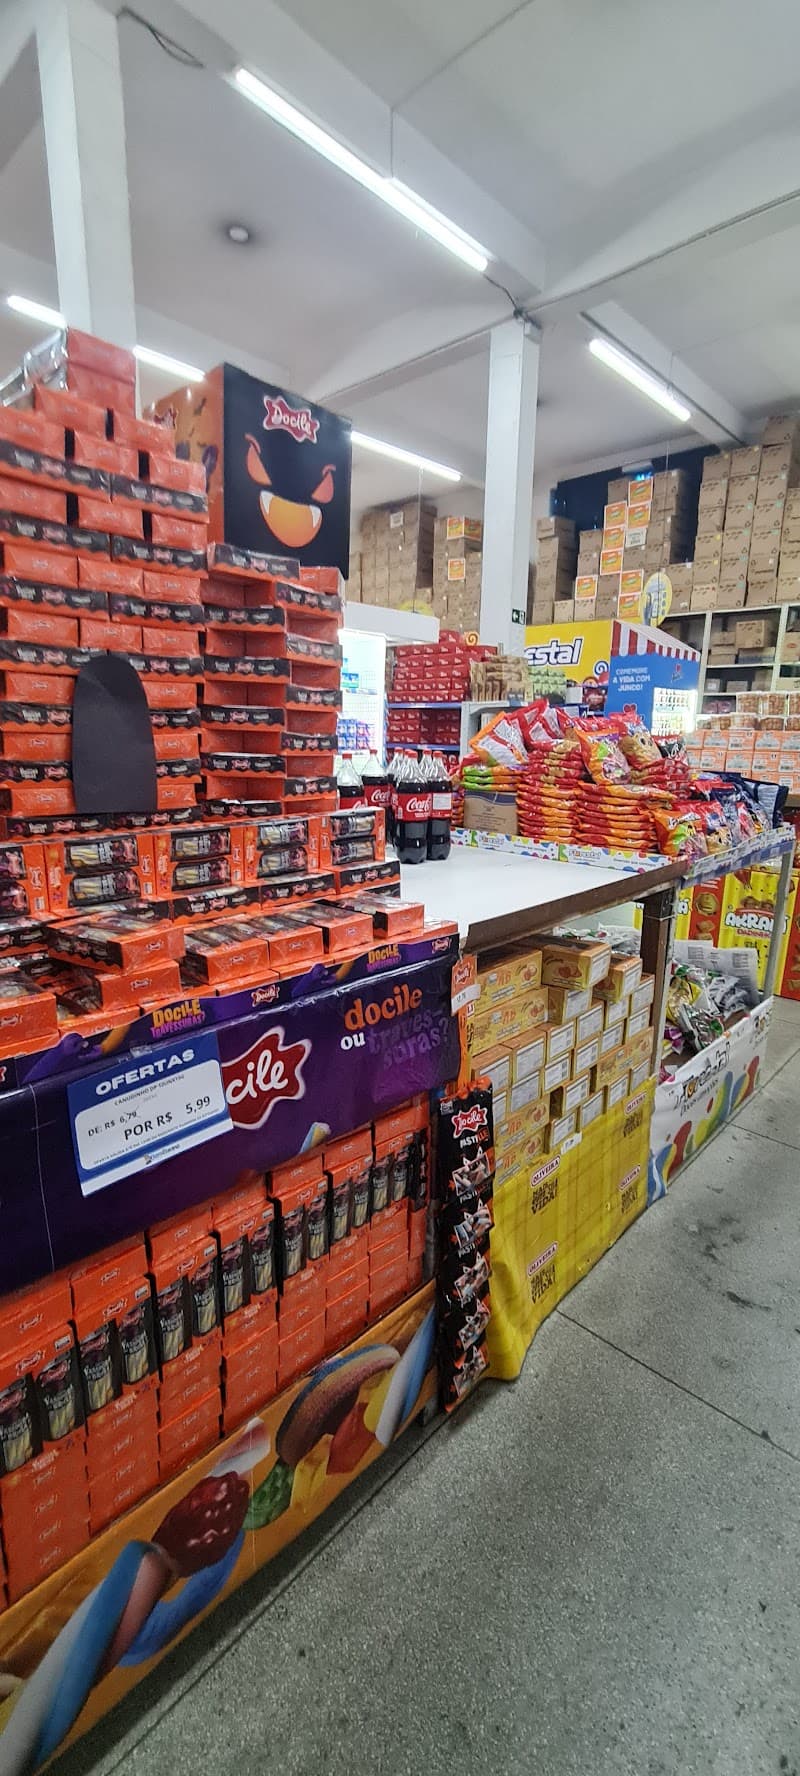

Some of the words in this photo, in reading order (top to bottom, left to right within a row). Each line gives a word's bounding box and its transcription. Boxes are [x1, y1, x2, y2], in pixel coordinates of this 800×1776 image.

[152, 998, 202, 1028] DOCILE
[344, 983, 424, 1031] docile
[339, 1032, 366, 1051] ou
[95, 1048, 196, 1096] OFERTAS
[104, 1119, 116, 1130] R$
[123, 1121, 153, 1141] POR
[156, 1111, 173, 1127] R$
[185, 1095, 211, 1115] 5,99
[532, 1157, 560, 1184] OLIVEIRA
[529, 1246, 556, 1273] OLIVEIRA
